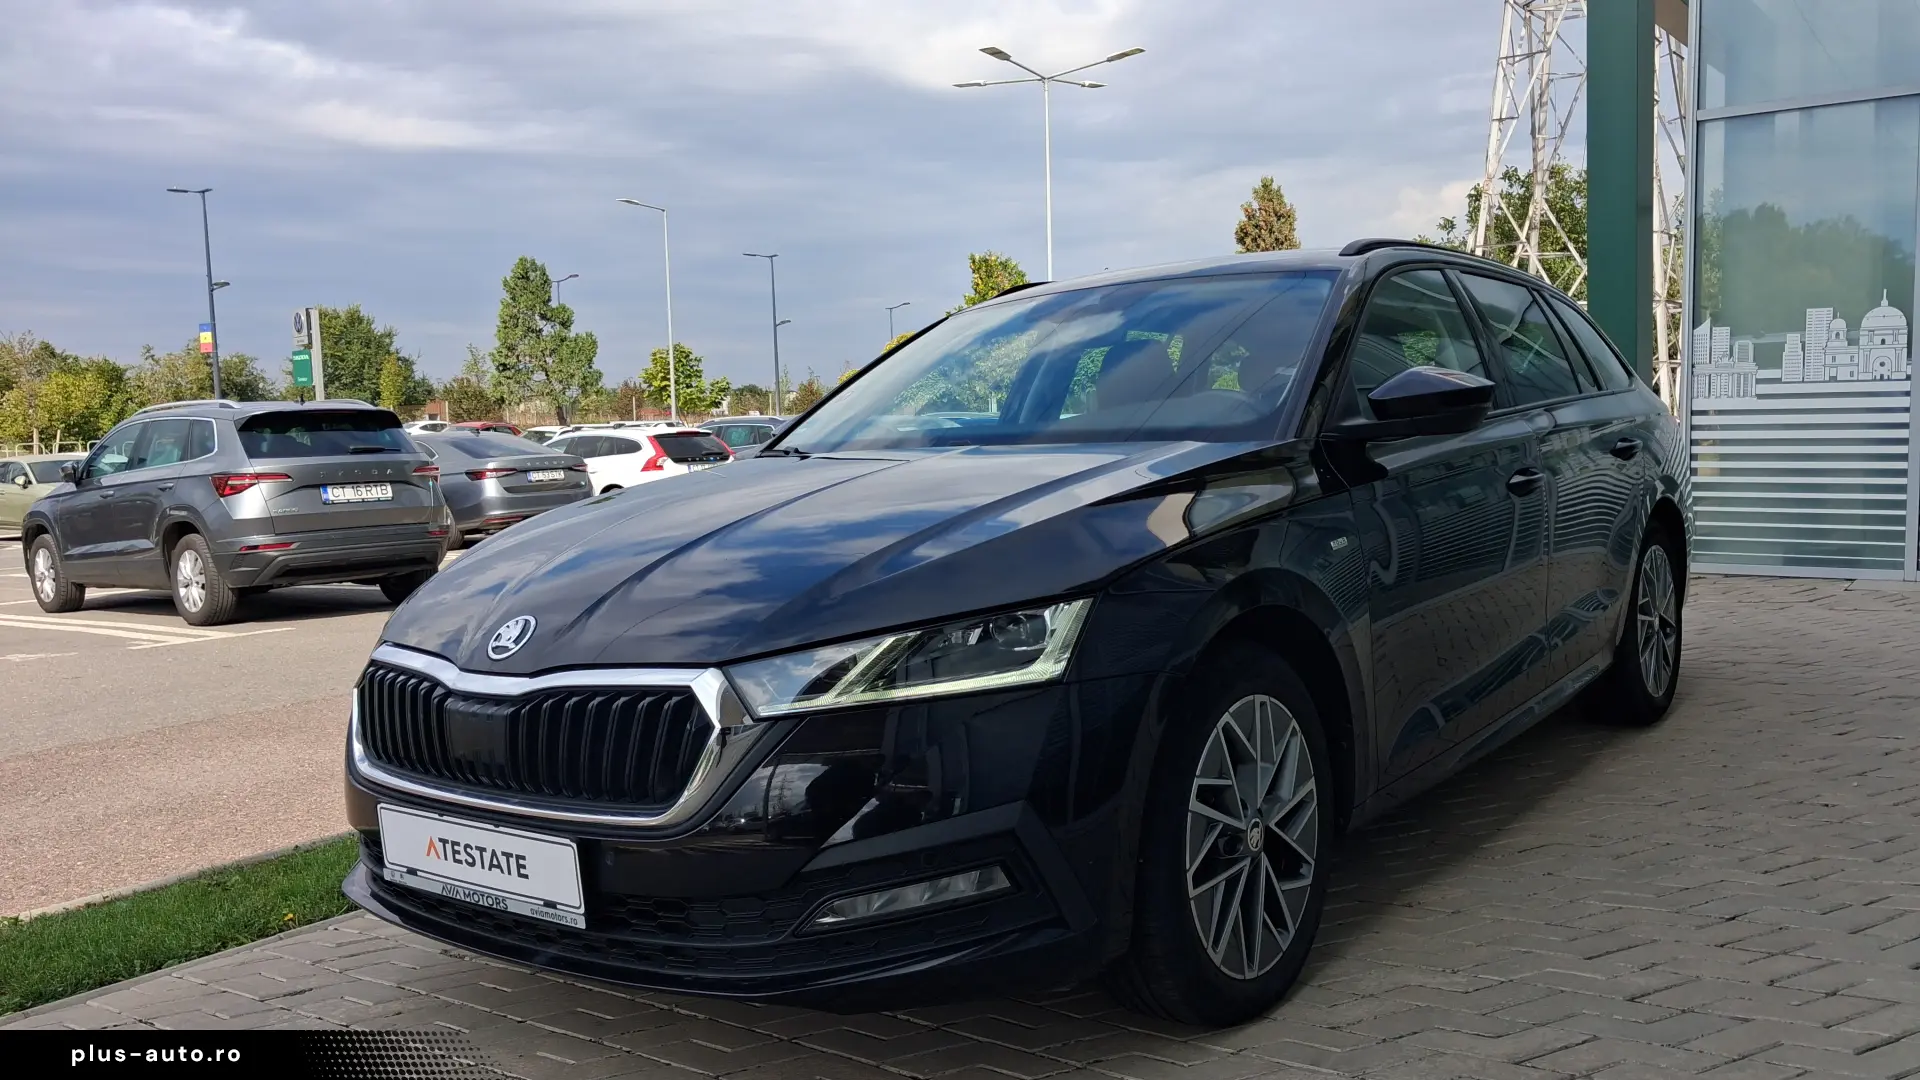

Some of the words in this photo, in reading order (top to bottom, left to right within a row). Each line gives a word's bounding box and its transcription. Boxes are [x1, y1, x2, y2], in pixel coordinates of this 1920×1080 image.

[331, 486, 346, 498] CT
[352, 485, 363, 497] 16
[364, 483, 389, 497] RTB
[426, 836, 529, 880] ATESTATE
[463, 889, 509, 911] MOTORS
[529, 906, 578, 926] aviamotors.ro
